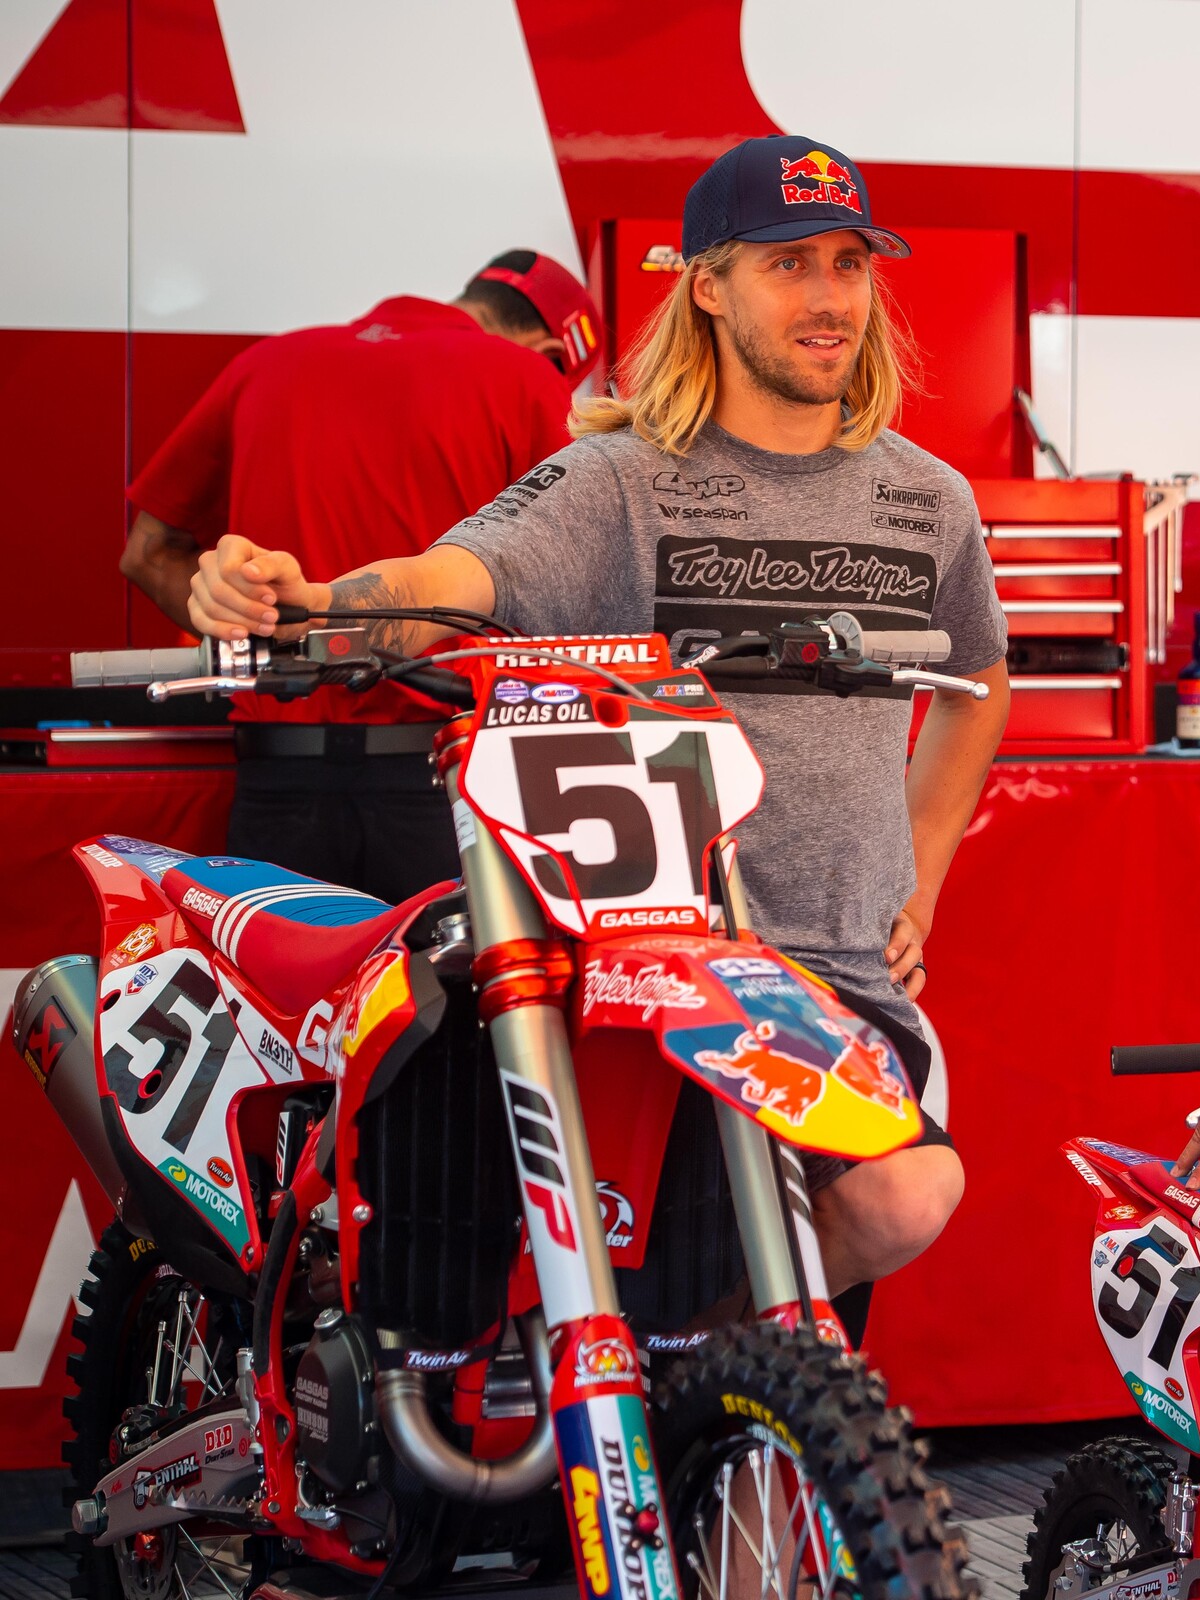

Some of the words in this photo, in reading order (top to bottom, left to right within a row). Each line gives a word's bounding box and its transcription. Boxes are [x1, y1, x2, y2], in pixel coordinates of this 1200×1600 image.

[781, 183, 829, 205] Red
[828, 183, 862, 214] Bull
[653, 471, 746, 499] 4WP
[683, 507, 749, 521] seaspan
[888, 516, 936, 534] MOTOREX
[667, 544, 749, 596] Troy
[745, 548, 811, 591] Lee
[810, 546, 931, 600] Designs
[496, 643, 658, 668] RENTHAL
[652, 684, 685, 697] AMA
[684, 684, 705, 692] PRO
[487, 704, 553, 727] LUCAS
[556, 702, 590, 721] OIL
[510, 730, 723, 900] 51
[81, 844, 124, 868] DUNLOP
[182, 886, 224, 917] GASGAS
[600, 910, 696, 928] GASGAS
[102, 958, 242, 1155] 51
[259, 1028, 294, 1071] BN3TH
[209, 1161, 225, 1178] Twin
[221, 1171, 233, 1184] Air
[1066, 1152, 1102, 1187] DUNLOP
[185, 1173, 241, 1227] MOTOREX
[1164, 1184, 1200, 1209] GASGAS
[1101, 1236, 1120, 1253] AMA
[648, 1335, 686, 1349] Twin
[406, 1351, 446, 1366] Twin
[448, 1351, 471, 1364] Air
[297, 1376, 329, 1400] GASGAS
[1142, 1388, 1192, 1434] MOTOREX
[570, 1465, 611, 1596] 4WP
